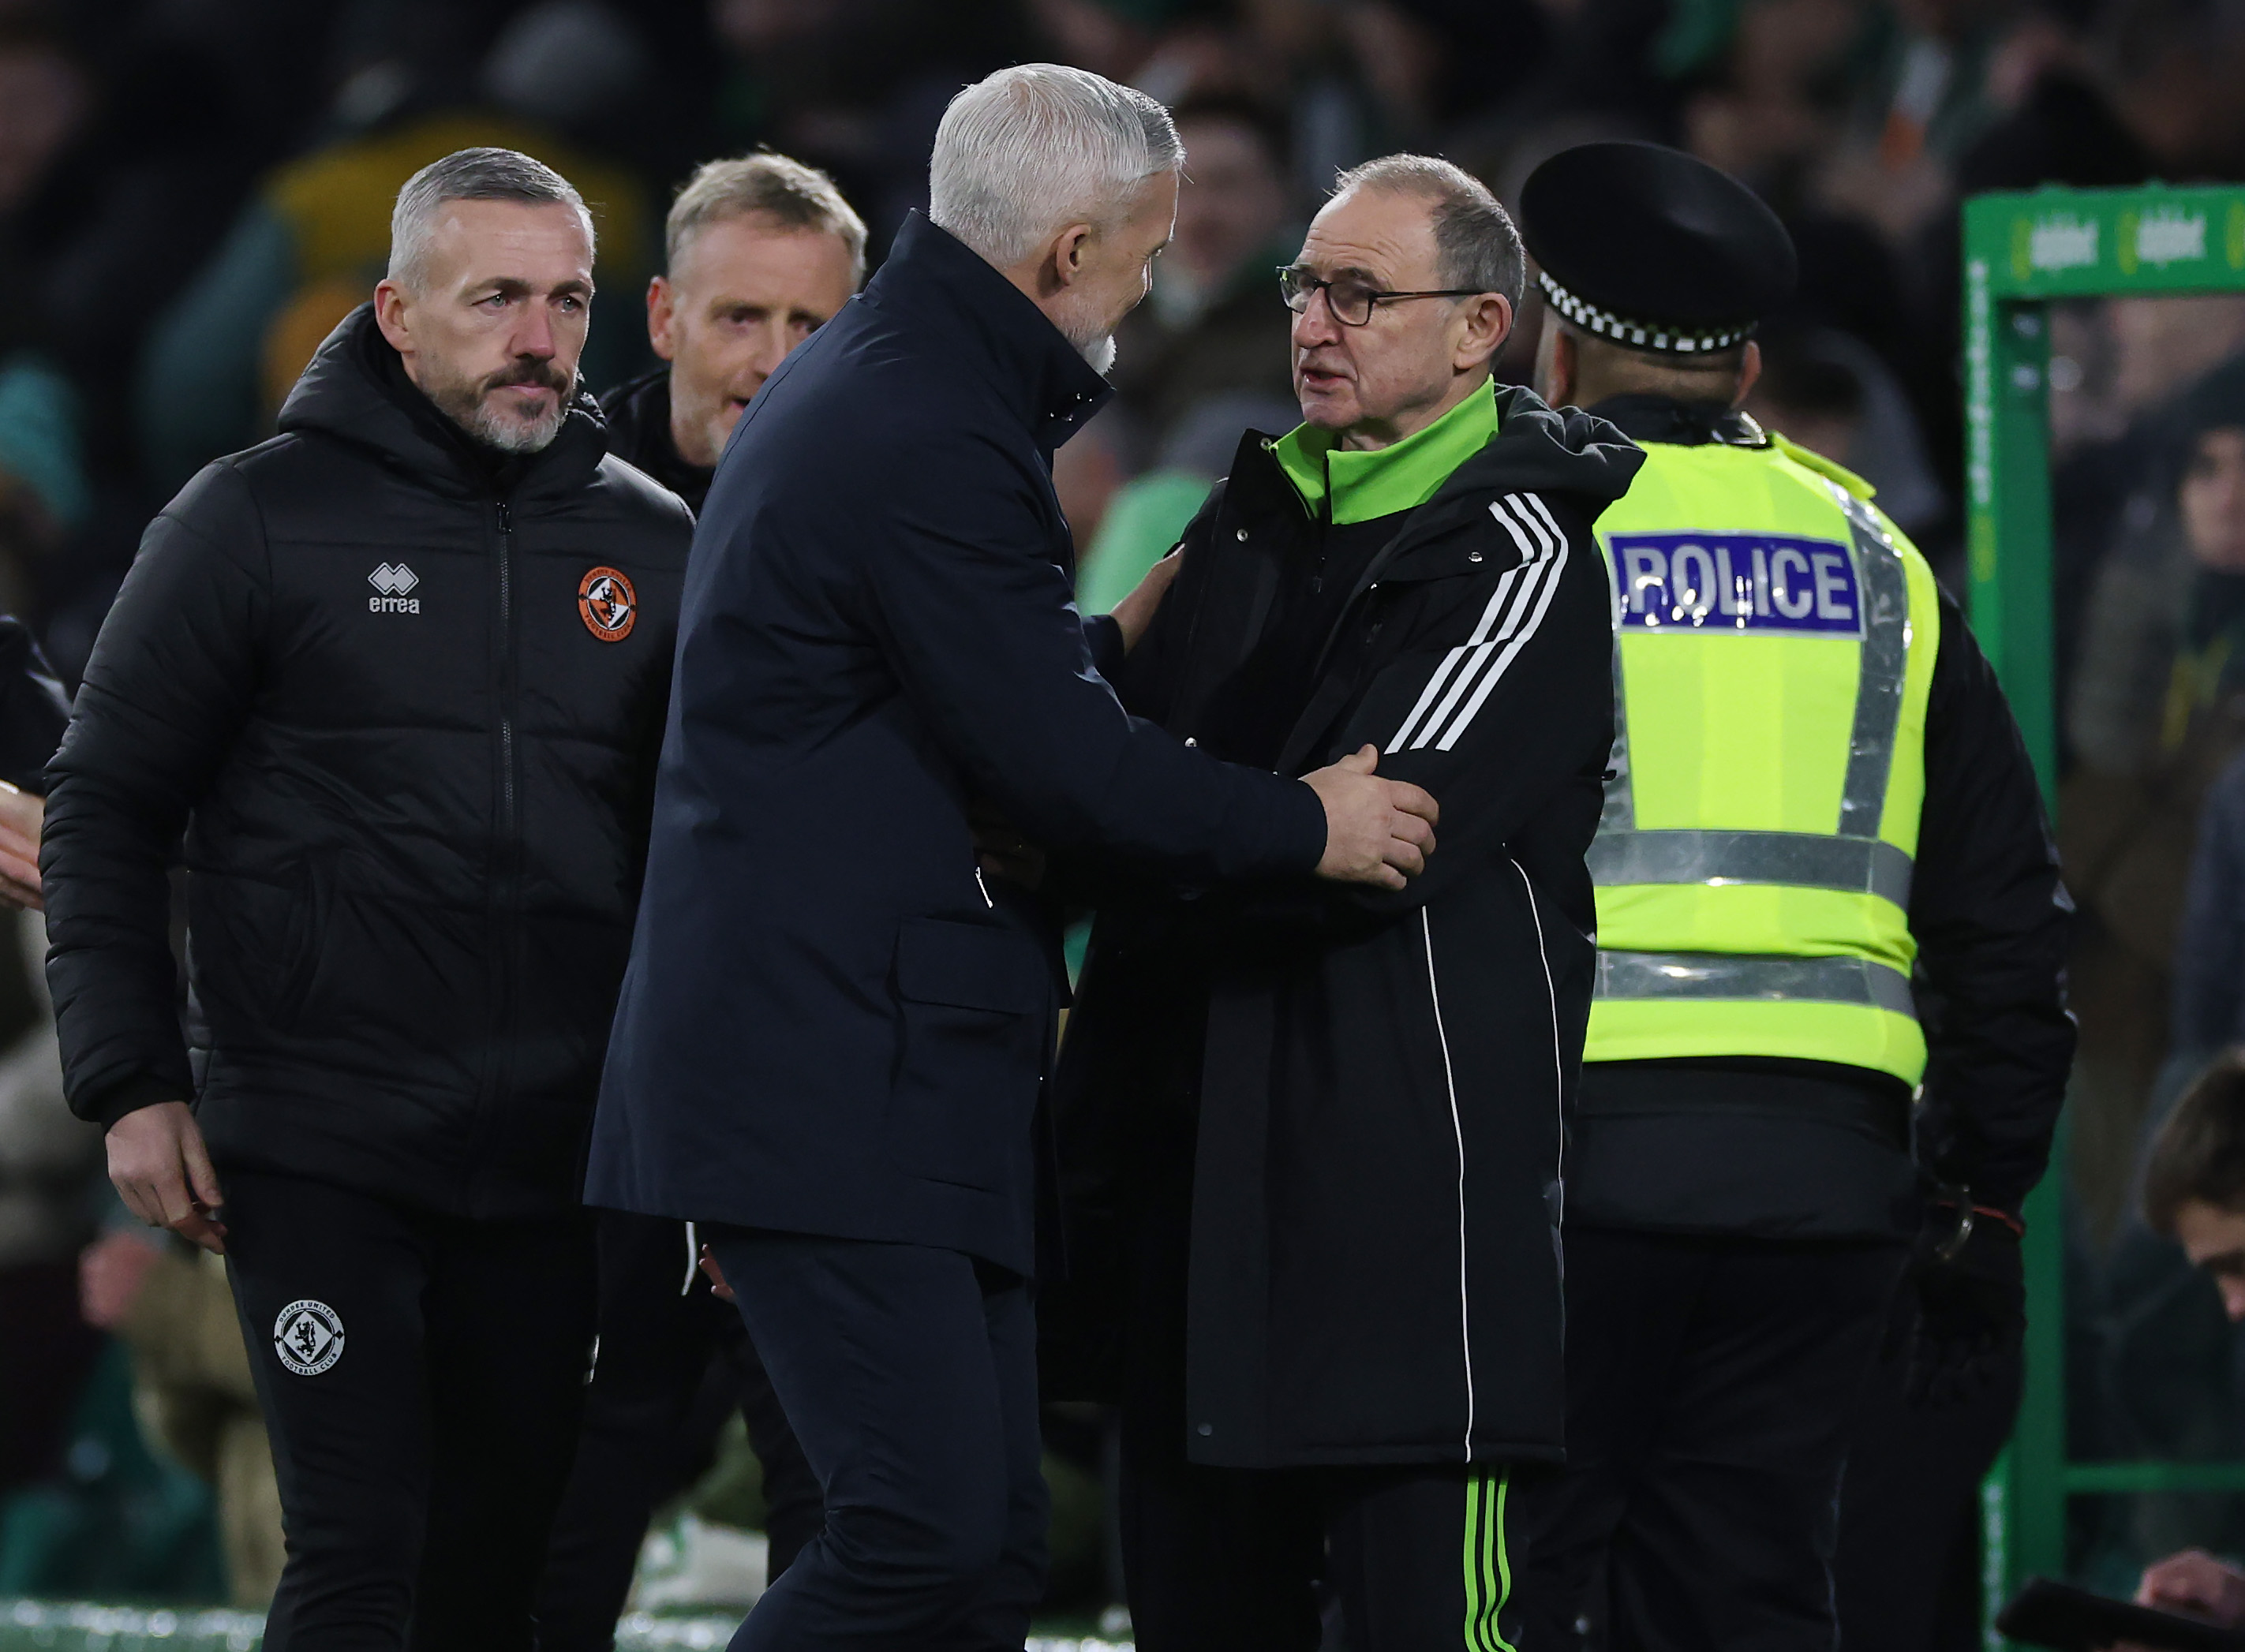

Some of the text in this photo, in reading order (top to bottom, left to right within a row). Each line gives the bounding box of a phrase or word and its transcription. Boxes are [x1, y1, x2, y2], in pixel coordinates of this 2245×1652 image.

[1622, 544, 1853, 620] POLICE
[369, 597, 420, 615] errea
[279, 1302, 335, 1322] DUNDEE UNITED
[282, 1352, 337, 1374] FOOTBALL CLUB
